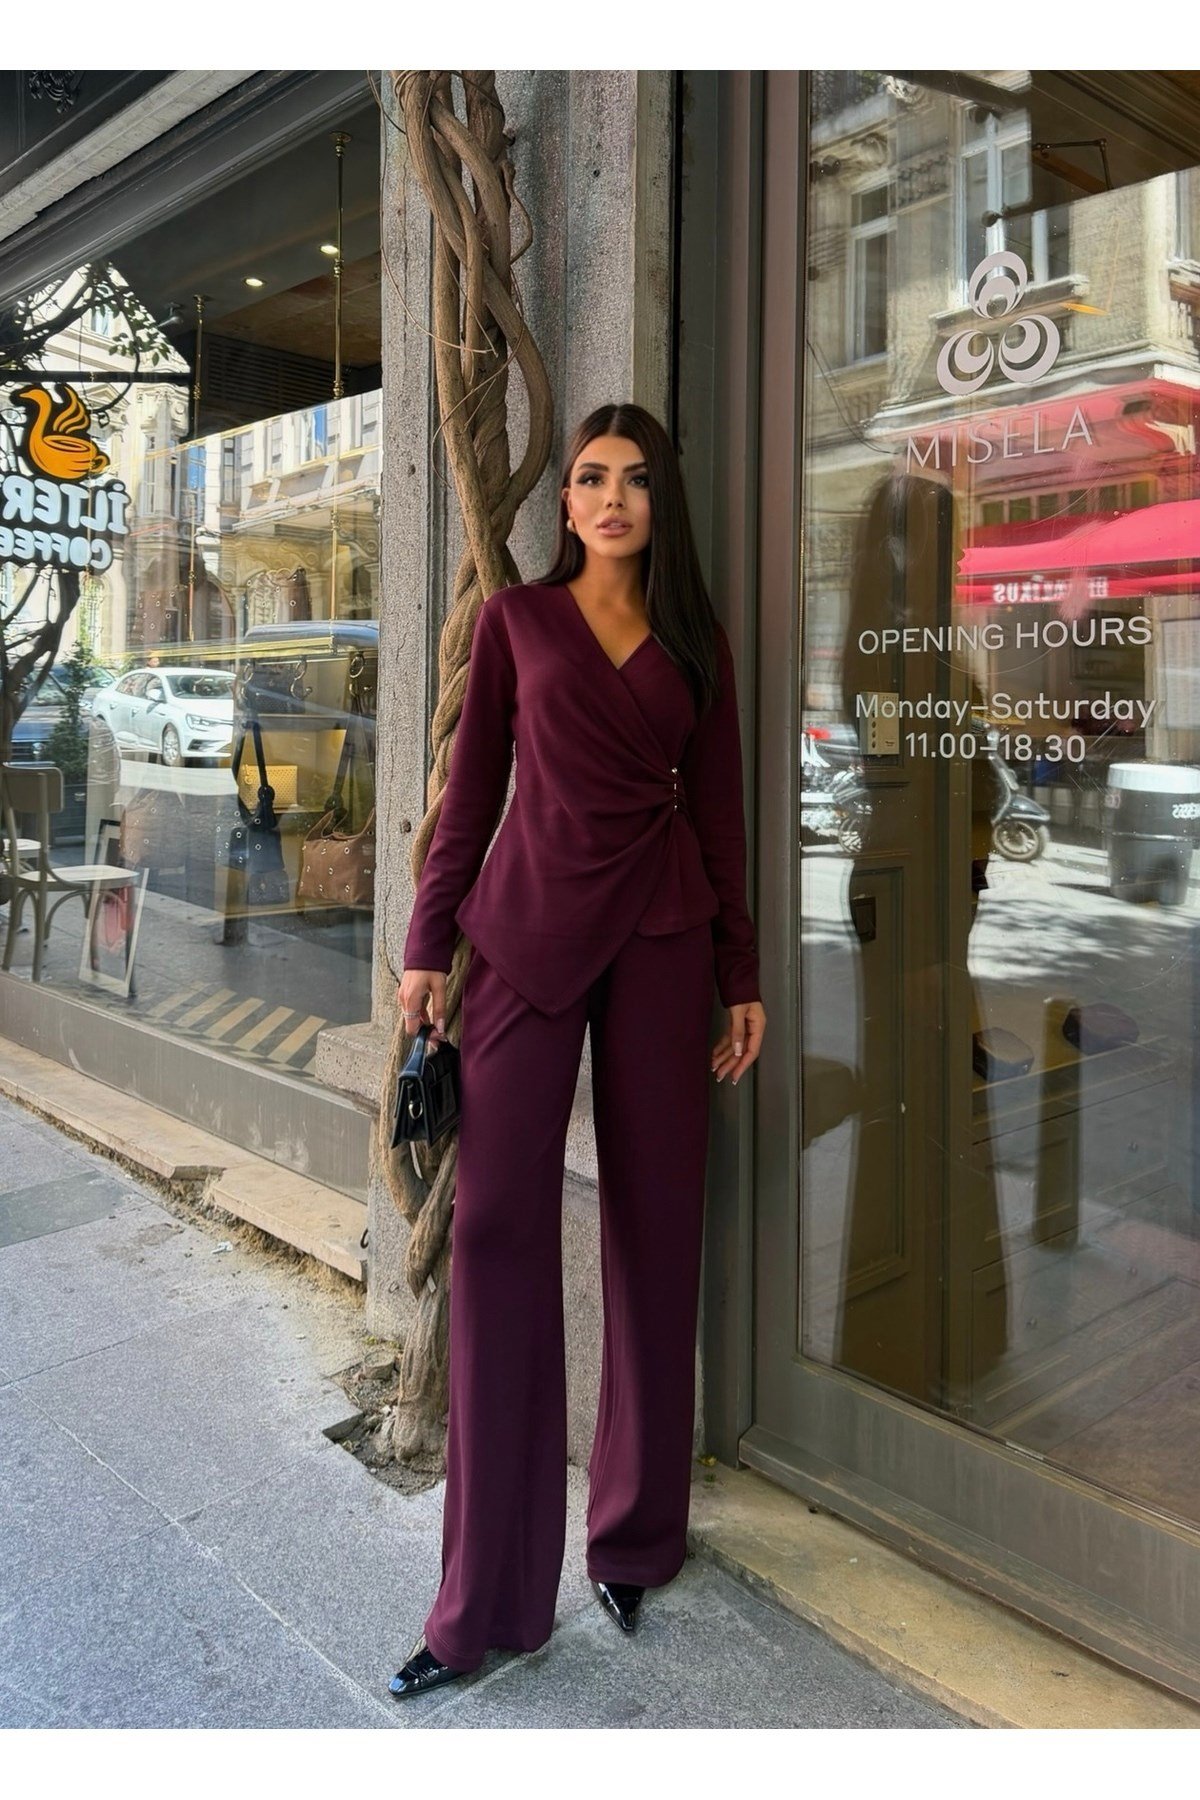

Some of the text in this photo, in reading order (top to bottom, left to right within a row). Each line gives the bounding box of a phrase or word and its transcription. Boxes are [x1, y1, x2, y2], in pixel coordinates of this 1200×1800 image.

[906, 405, 1093, 474] MISELA
[858, 616, 1153, 655] OPENING HOURS
